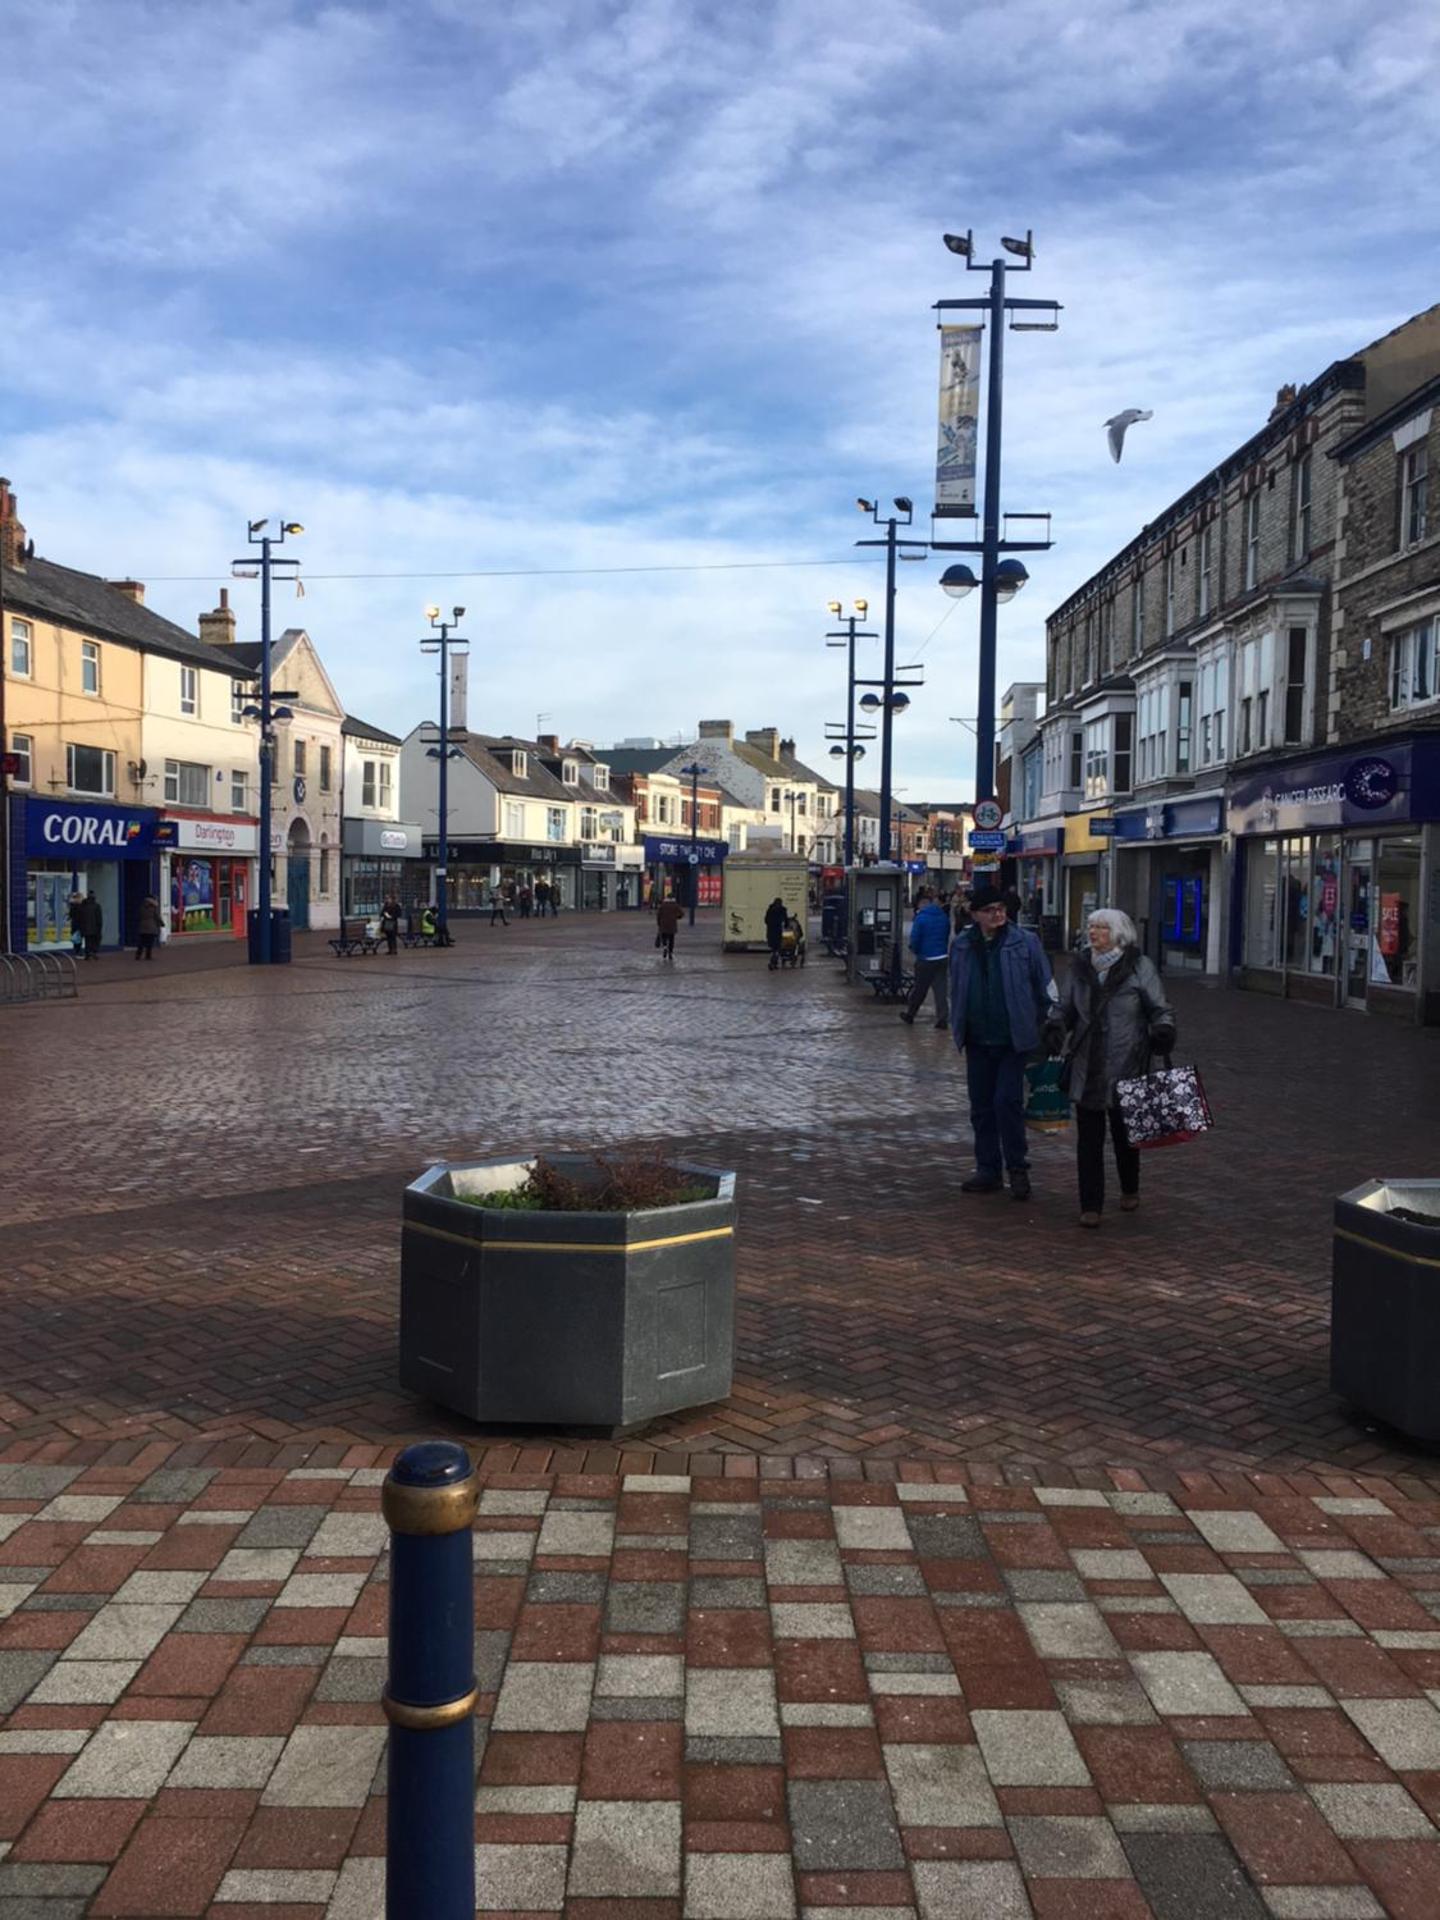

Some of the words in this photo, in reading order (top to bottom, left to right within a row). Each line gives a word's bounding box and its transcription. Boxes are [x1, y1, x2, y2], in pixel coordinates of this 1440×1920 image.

[1275, 790, 1304, 809] CANCER
[1307, 782, 1347, 805] RESEARC
[43, 813, 128, 846] CORAL
[195, 823, 235, 847] Darlington
